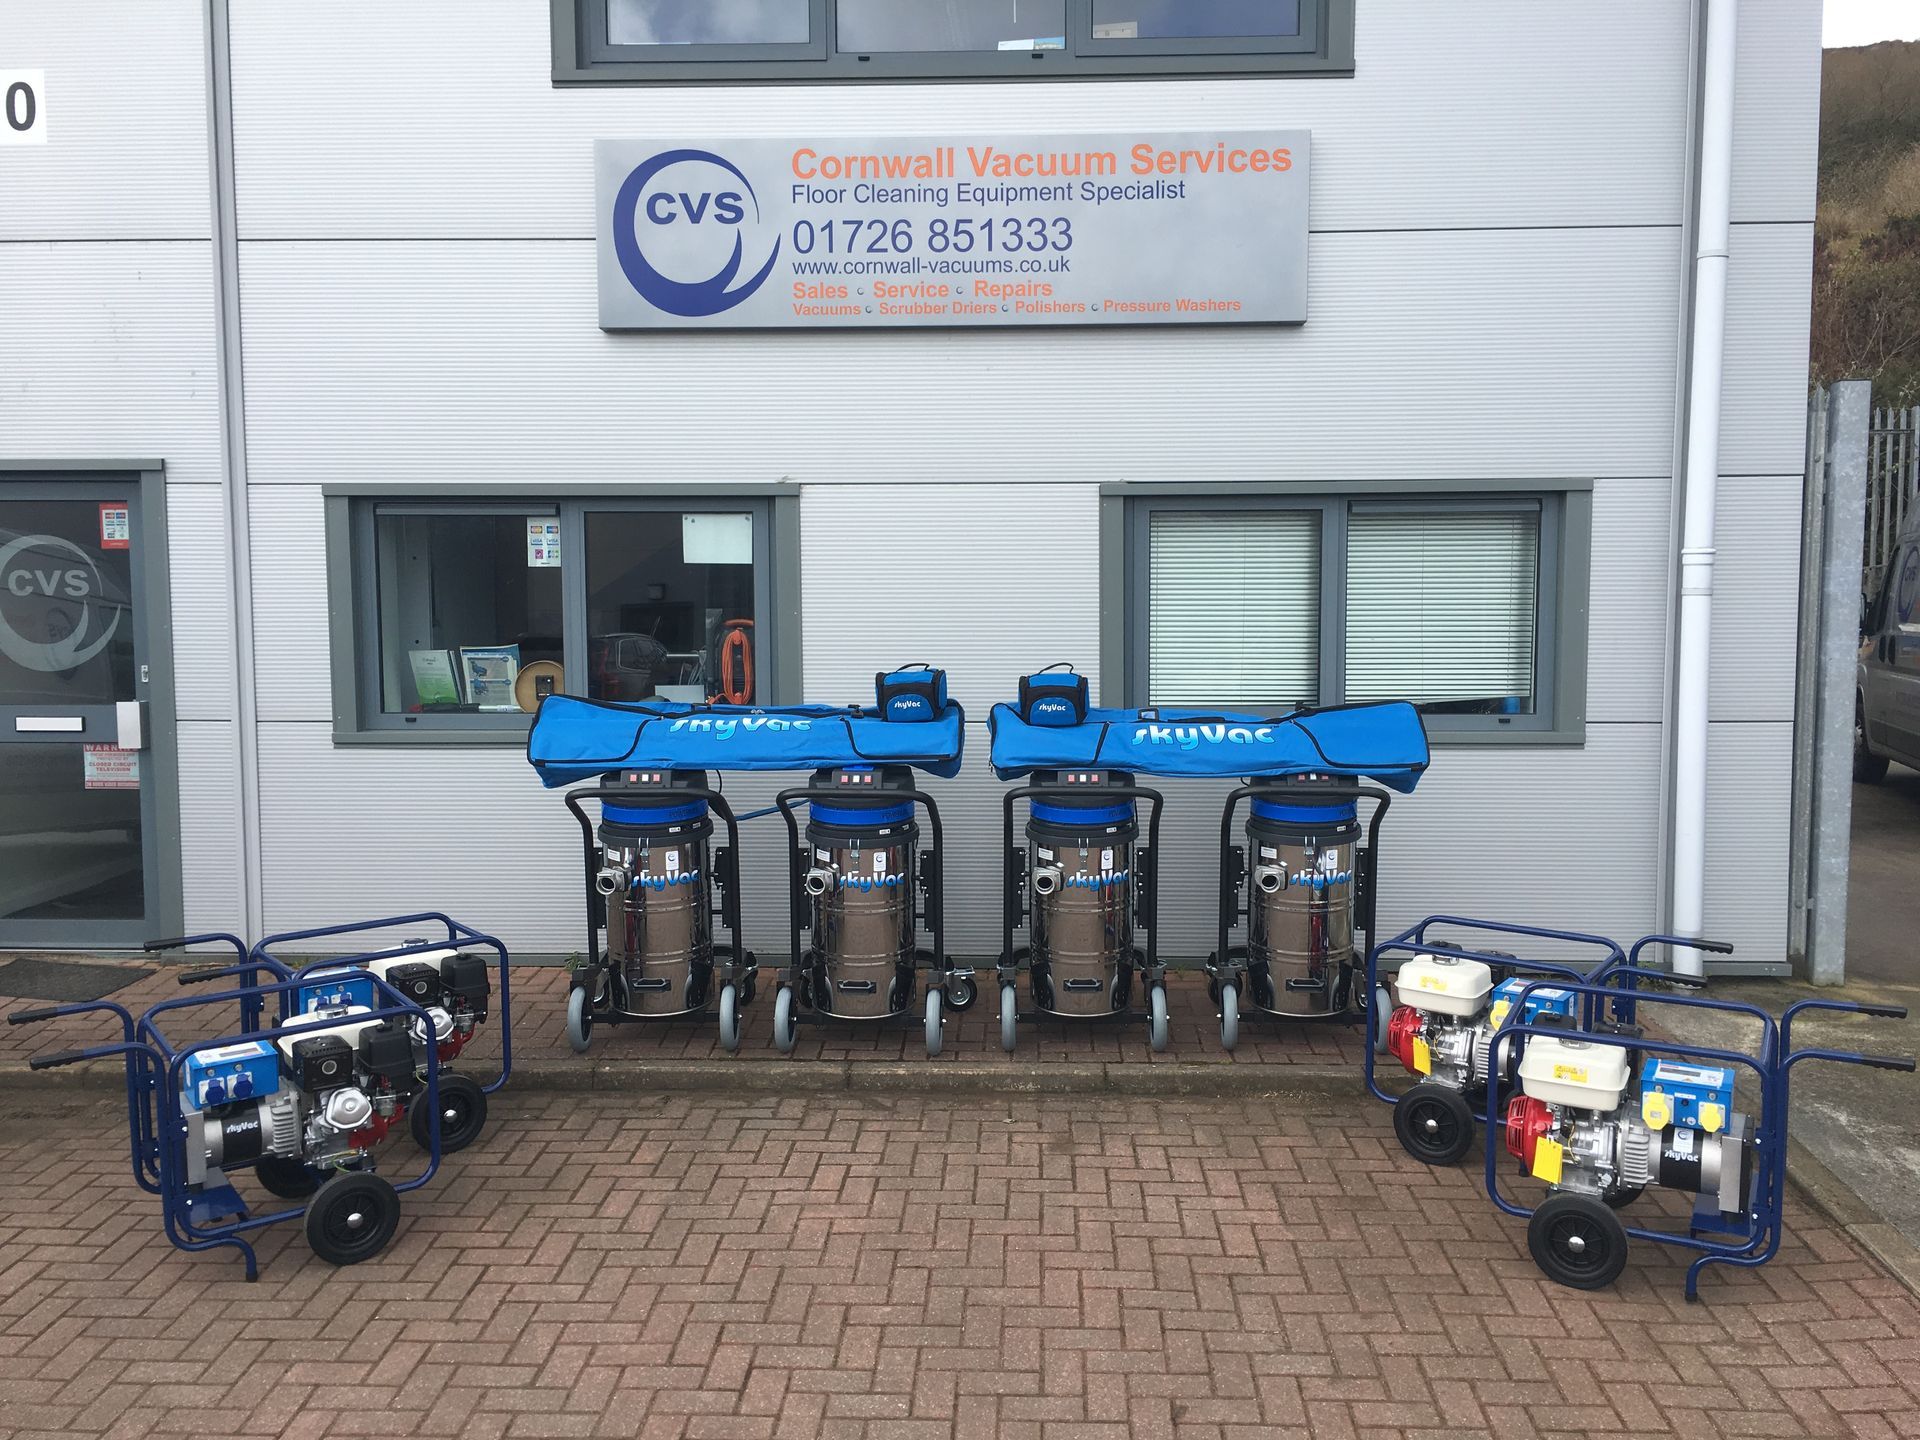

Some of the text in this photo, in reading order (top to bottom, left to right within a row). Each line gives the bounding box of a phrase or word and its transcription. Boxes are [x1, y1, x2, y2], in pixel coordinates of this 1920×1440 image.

[5, 81, 36, 131] 0
[792, 142, 1292, 180] Cornwall Vacuum Services
[792, 179, 1186, 208] Floor Cleaning Equipment Specialist
[646, 192, 744, 225] CVS
[792, 217, 1073, 254] 01726 851333
[792, 256, 1071, 275] www.cornwall-vacuums.co.uk
[792, 279, 1053, 301] Sales Service Repairs
[793, 297, 1241, 316] Vacuums Scrubber Driers Polishers Pressure Washers
[7, 569, 90, 597] CVS
[894, 700, 921, 709] skyVac
[1038, 703, 1067, 712] skyVac
[669, 717, 813, 741] skyVac
[1132, 724, 1277, 750] skyVac
[226, 1121, 258, 1134] skyVac
[1664, 1149, 1699, 1163] skyVac
